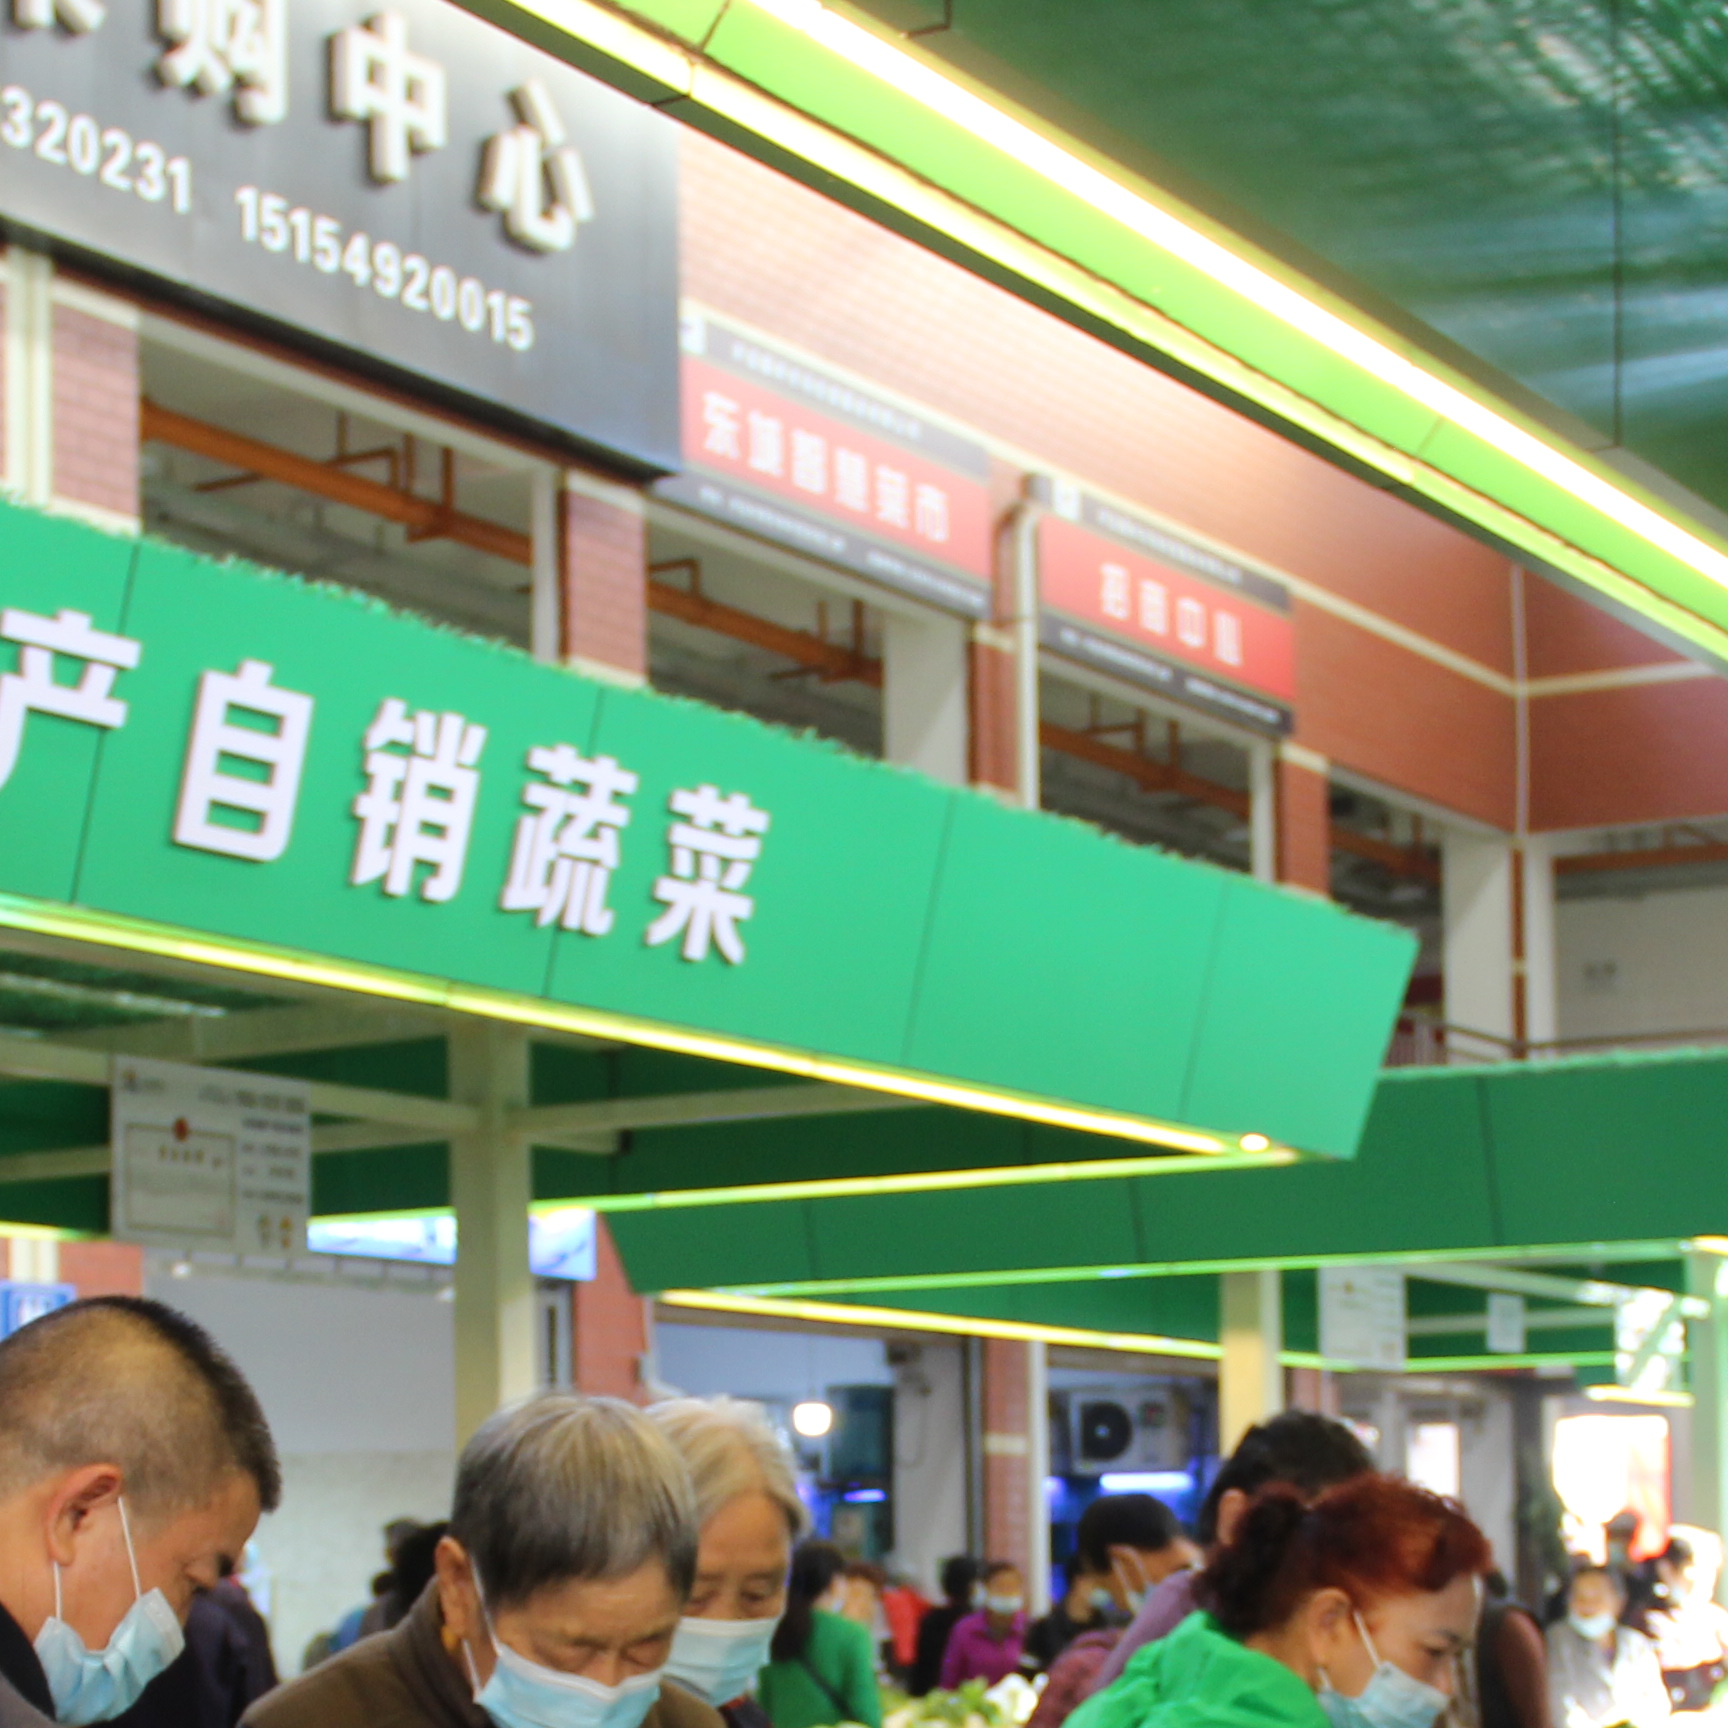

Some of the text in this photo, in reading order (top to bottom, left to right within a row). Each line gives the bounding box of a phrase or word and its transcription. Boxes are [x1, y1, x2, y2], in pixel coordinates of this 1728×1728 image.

[12, 0, 596, 253] 购中心
[235, 185, 536, 351] 15154920015
